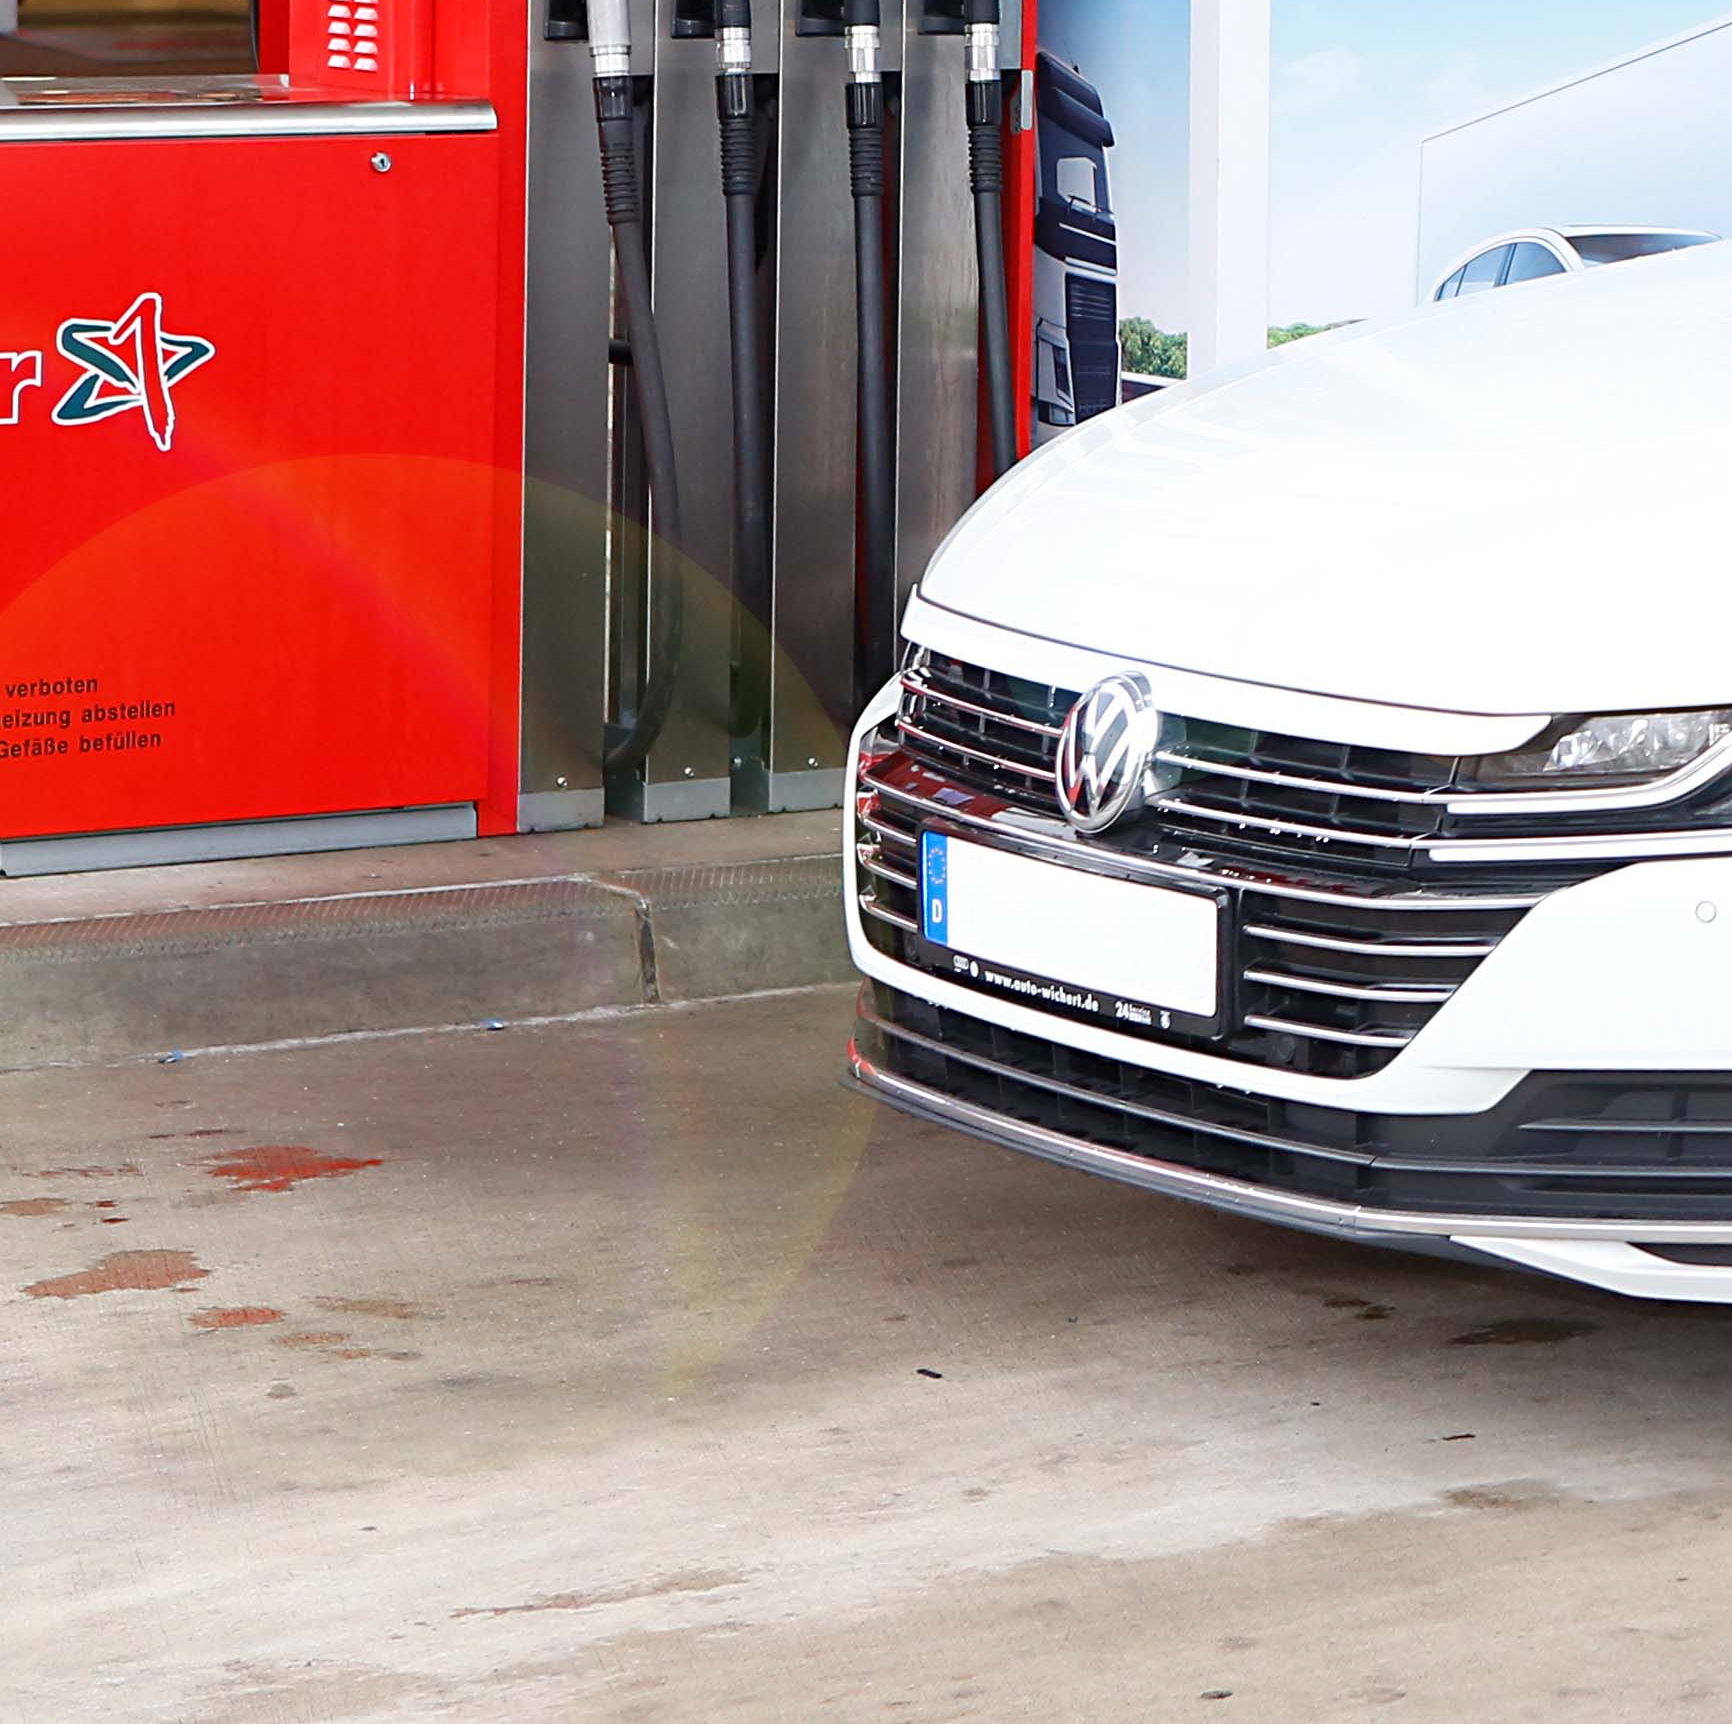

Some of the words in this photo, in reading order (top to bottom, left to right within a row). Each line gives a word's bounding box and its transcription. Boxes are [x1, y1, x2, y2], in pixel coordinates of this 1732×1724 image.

[5, 677, 98, 698] verboten
[82, 700, 175, 723] abstellen
[80, 731, 161, 753] befüllen
[932, 899, 942, 923] D
[984, 969, 1099, 1012] www.auto-wichert.de
